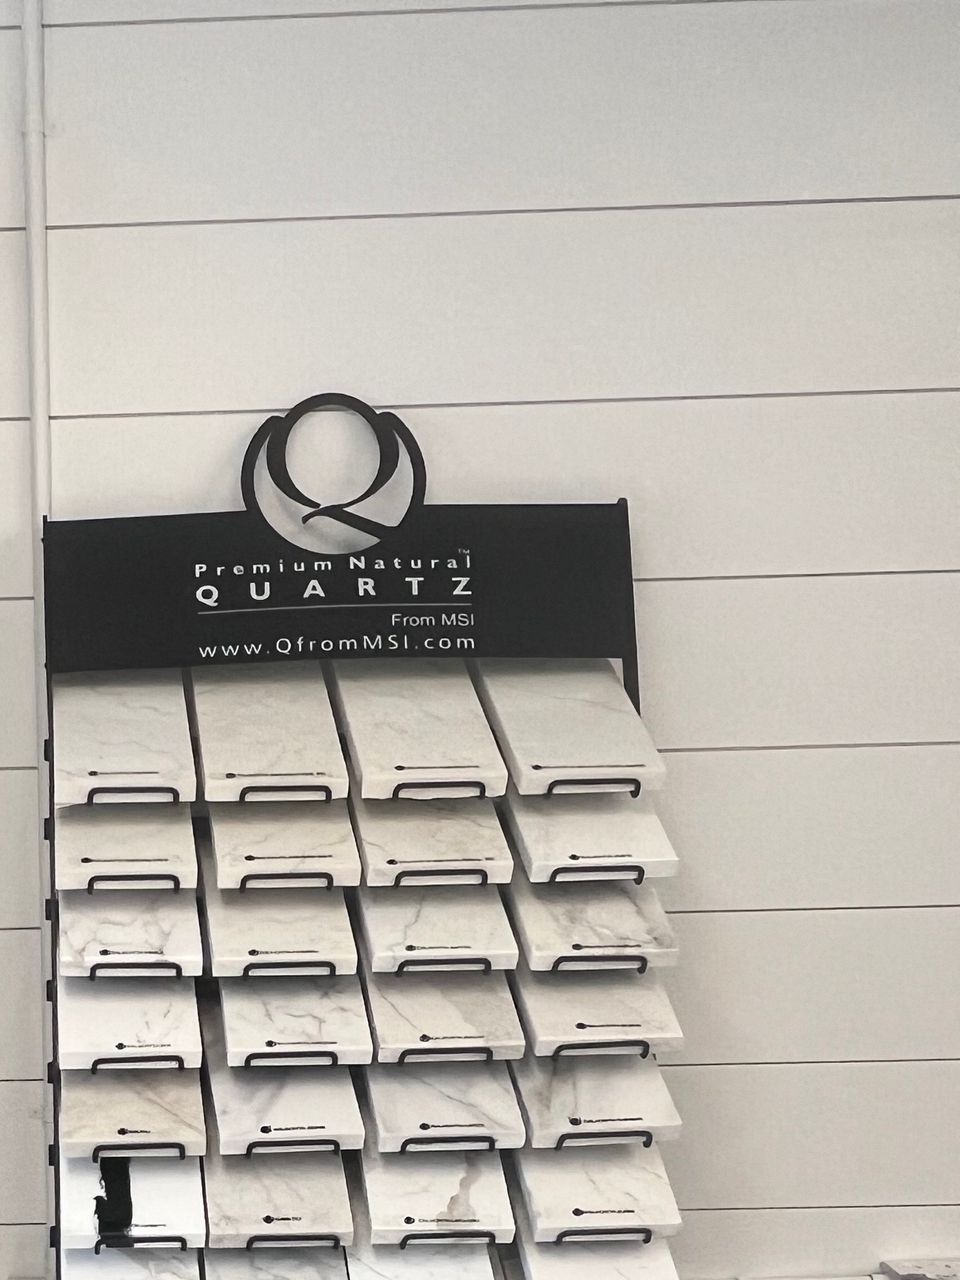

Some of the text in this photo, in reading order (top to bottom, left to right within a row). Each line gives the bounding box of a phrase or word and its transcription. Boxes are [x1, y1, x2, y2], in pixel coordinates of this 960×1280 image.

[195, 559, 332, 578] Premium
[349, 554, 471, 570] Natural
[196, 577, 473, 607] QUARTZ
[392, 613, 475, 627] From MSI
[199, 635, 475, 658] www.QfromMSI.com
